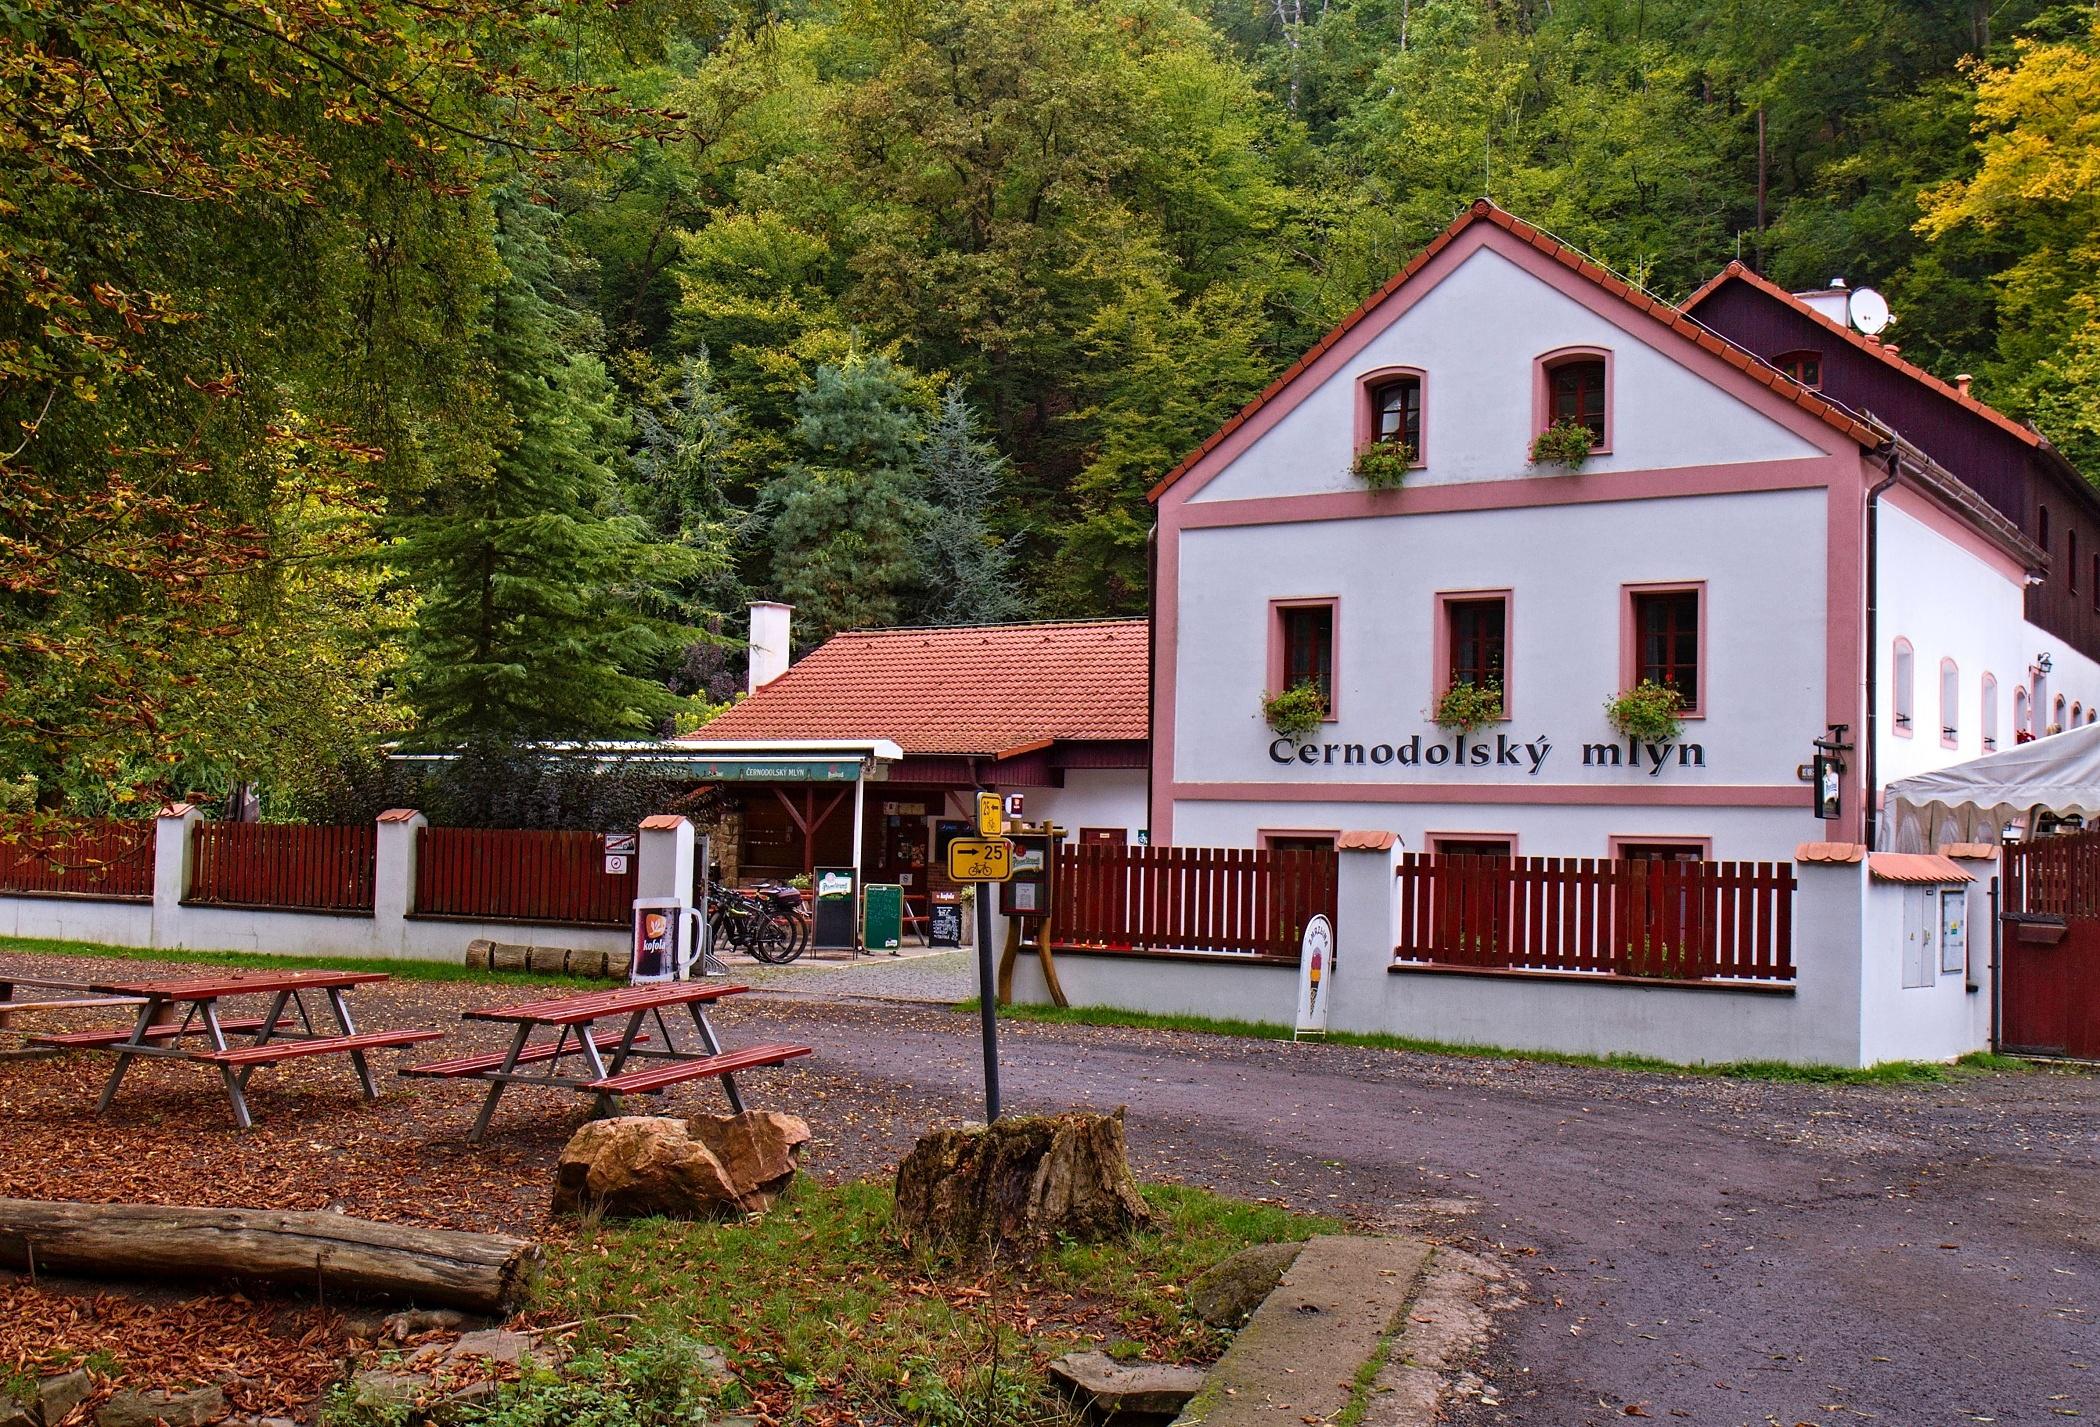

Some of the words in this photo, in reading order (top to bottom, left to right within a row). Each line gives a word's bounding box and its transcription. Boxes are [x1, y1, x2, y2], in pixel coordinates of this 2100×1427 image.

[1269, 729, 1552, 775] Černodolský
[1582, 733, 1706, 776] mlýn
[746, 767, 787, 777] ČERNODOLSKÝ
[788, 767, 804, 777] MLÝN
[984, 845, 1002, 860] 25
[643, 939, 666, 953] kofola
